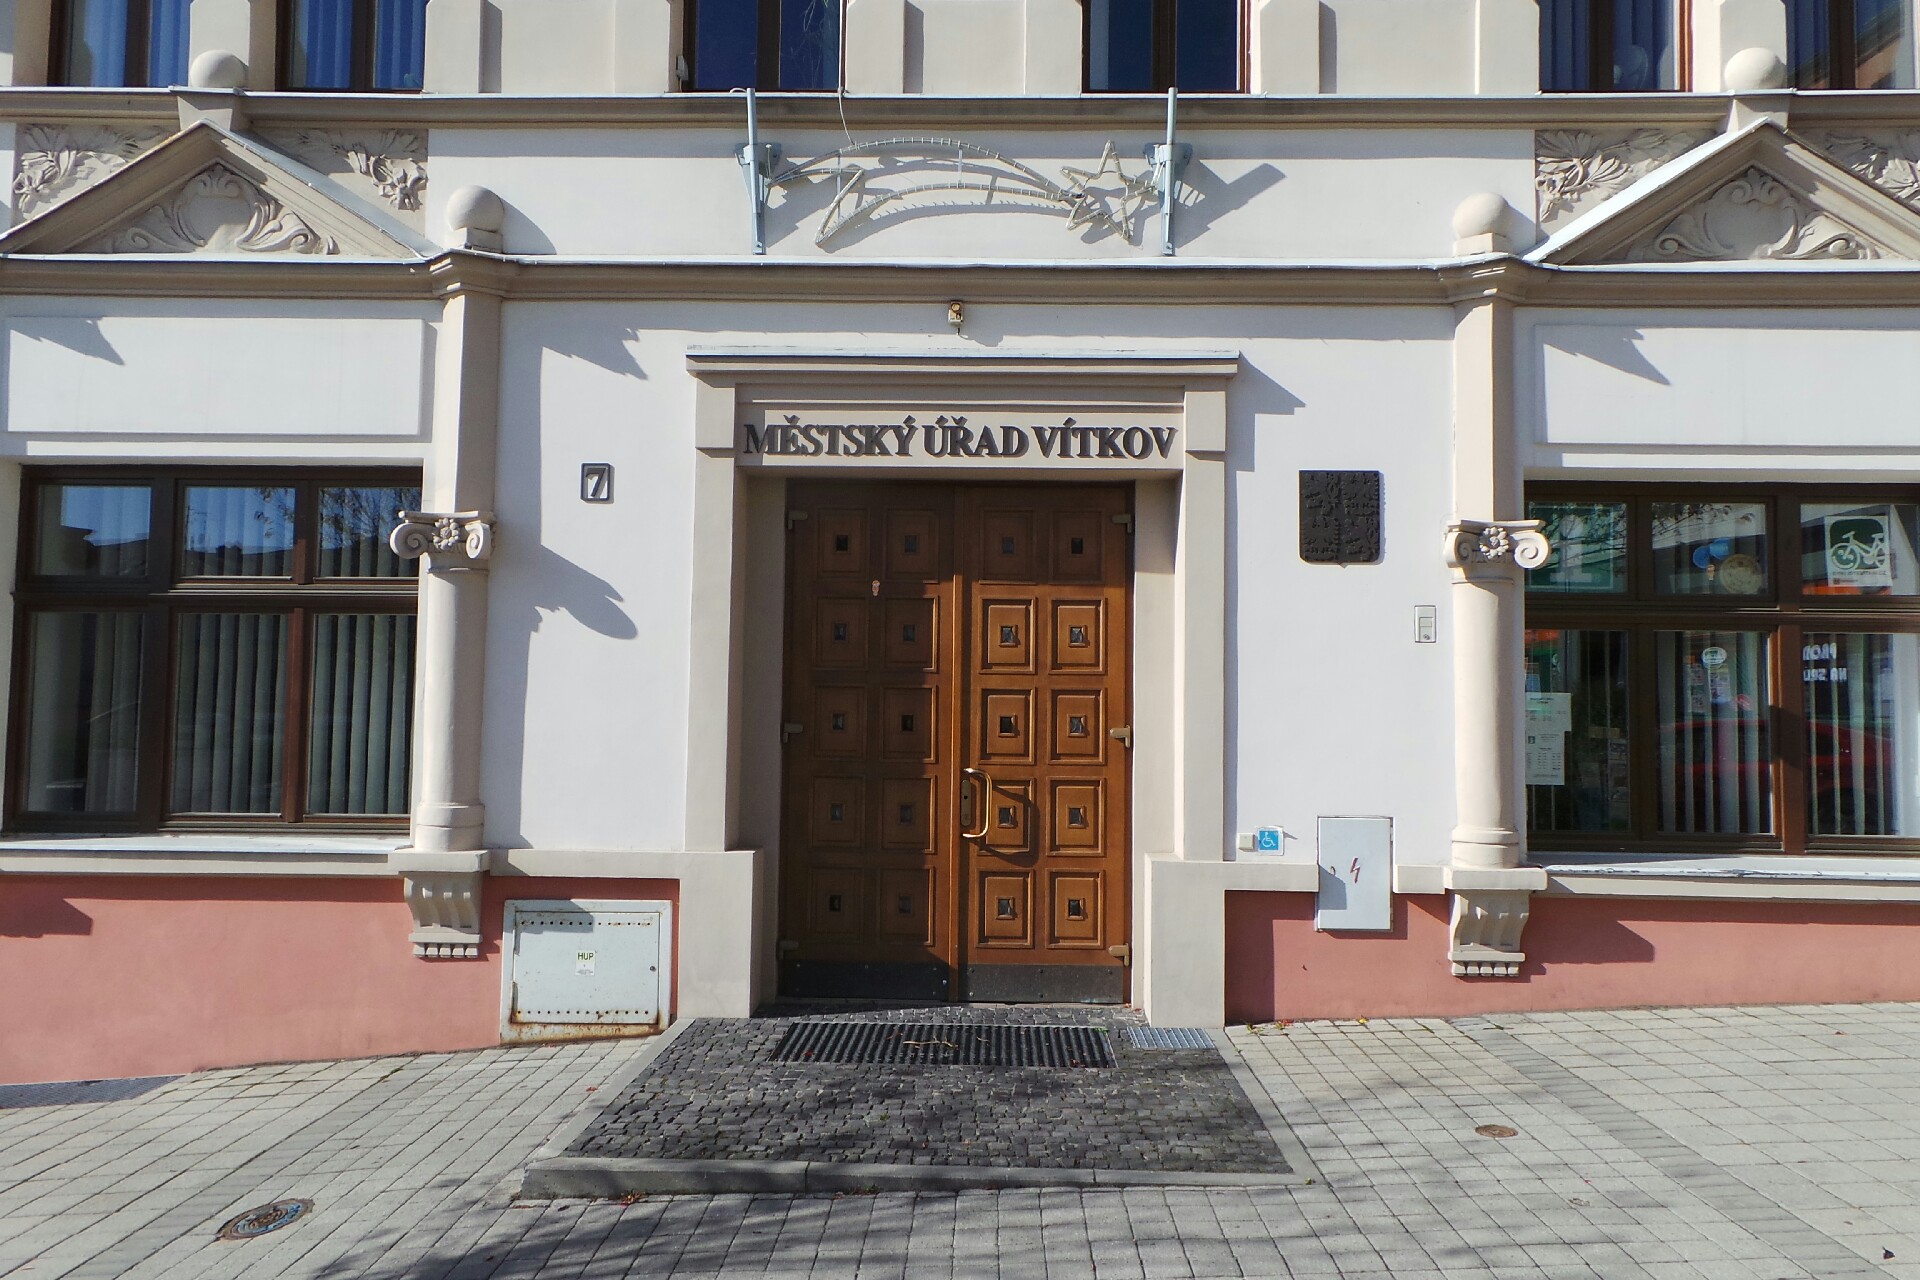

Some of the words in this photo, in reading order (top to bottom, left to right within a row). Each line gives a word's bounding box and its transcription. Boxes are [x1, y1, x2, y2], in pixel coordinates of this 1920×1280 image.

[743, 414, 919, 457] MĚSTSKÝ
[921, 415, 1029, 458] ÚŘAD
[1031, 416, 1179, 459] VÍTKOV
[585, 467, 606, 497] 7
[577, 952, 594, 960] HUP
